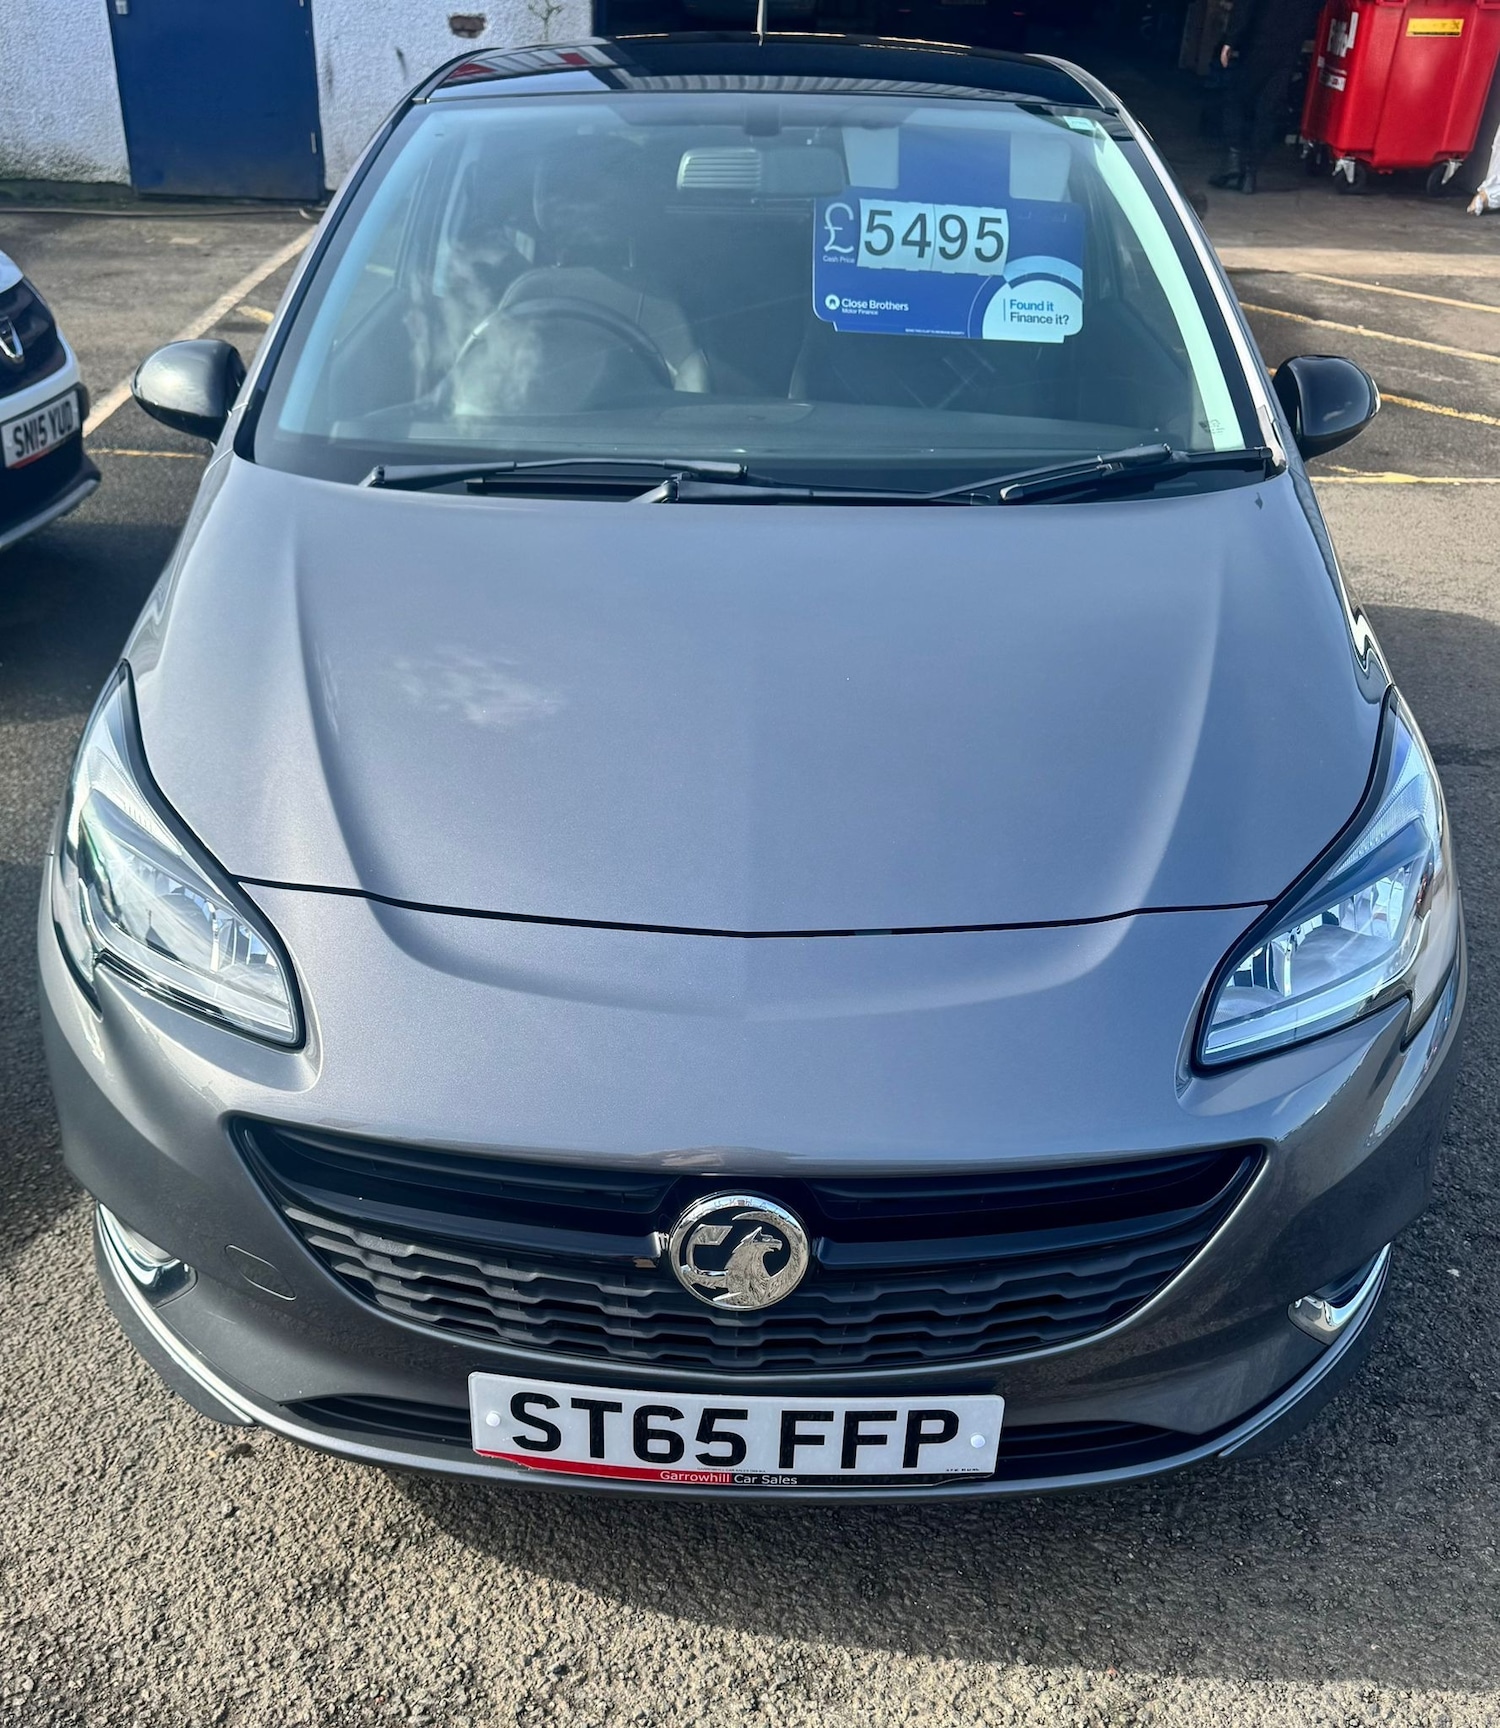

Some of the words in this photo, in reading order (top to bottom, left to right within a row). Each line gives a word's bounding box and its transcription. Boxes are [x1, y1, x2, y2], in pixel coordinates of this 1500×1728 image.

[823, 202, 1005, 263] £5495
[822, 255, 839, 263] Cash
[839, 256, 856, 264] Price
[841, 298, 868, 309] Close
[869, 300, 909, 312] Brothers
[1010, 299, 1044, 312] Found
[1046, 301, 1054, 312] it
[1010, 312, 1053, 325] Finance
[1055, 314, 1070, 326] it?
[13, 414, 48, 459] SN15
[510, 1391, 749, 1467] ST65
[778, 1409, 960, 1469] FFP
[659, 1470, 731, 1484] Garrowhill
[733, 1473, 758, 1485] Car
[761, 1474, 798, 1486] Sales
